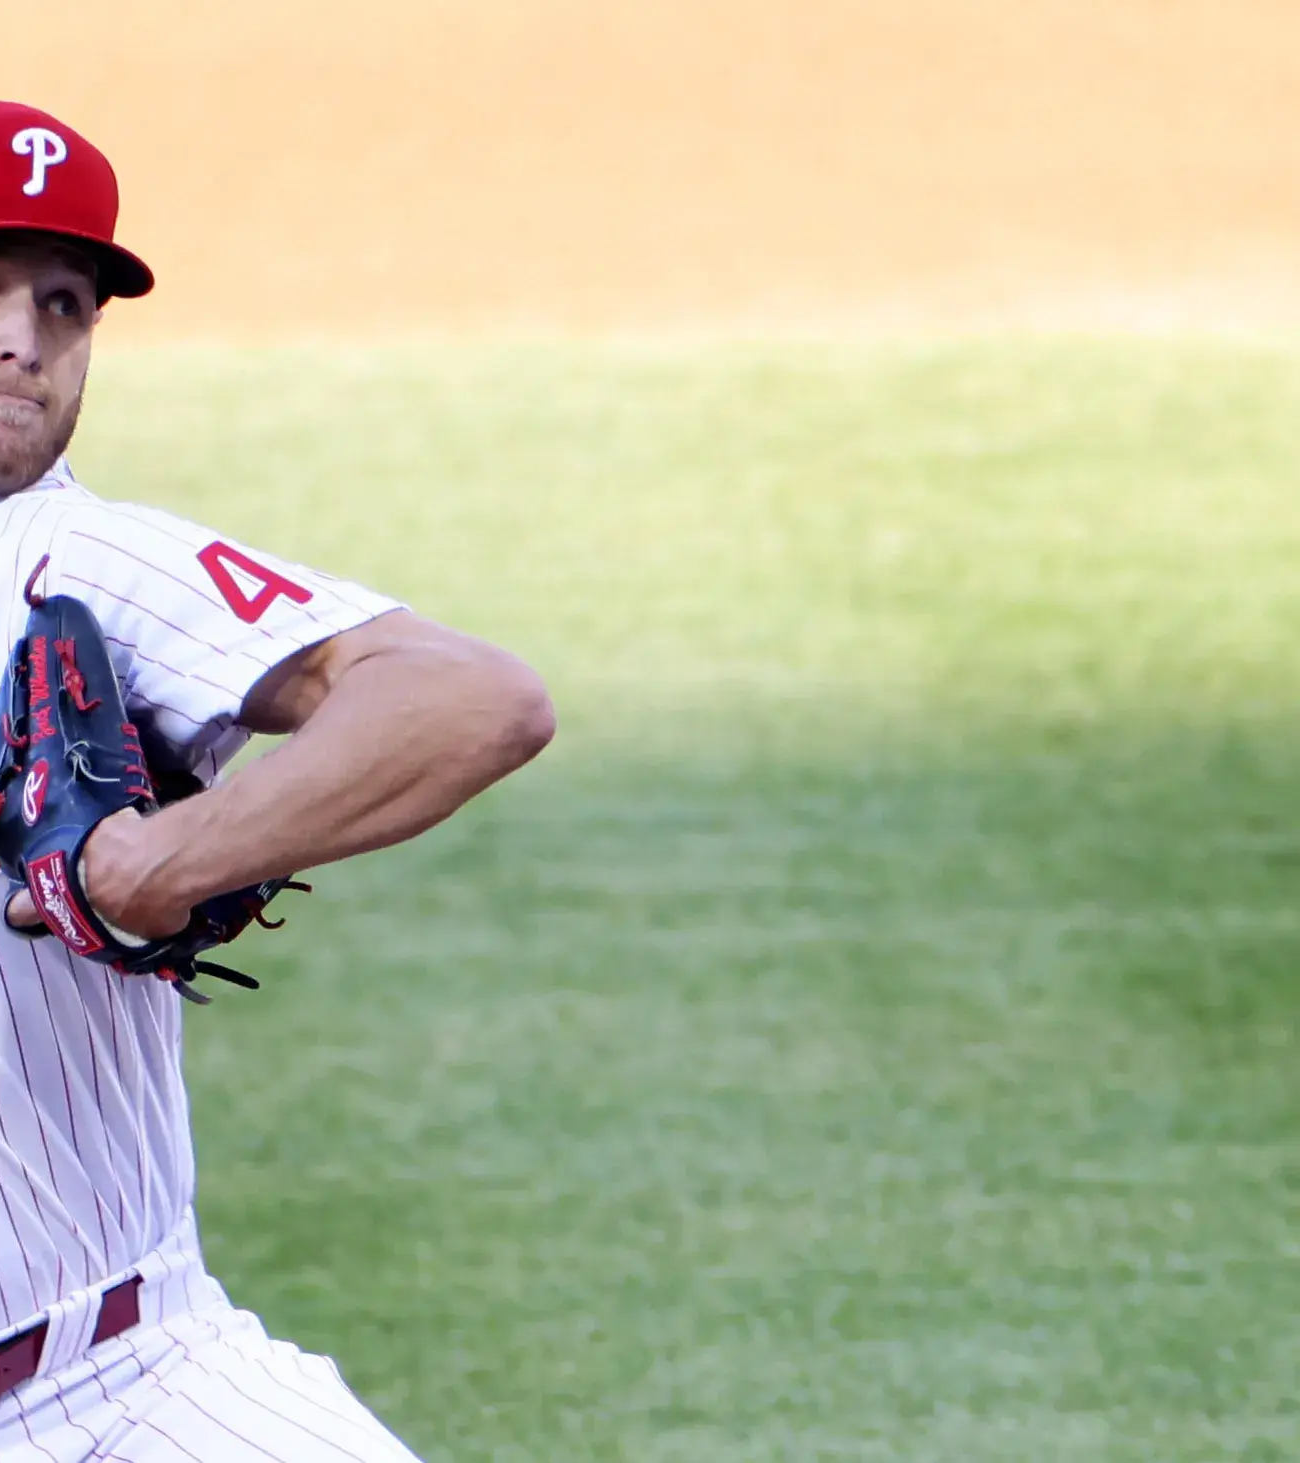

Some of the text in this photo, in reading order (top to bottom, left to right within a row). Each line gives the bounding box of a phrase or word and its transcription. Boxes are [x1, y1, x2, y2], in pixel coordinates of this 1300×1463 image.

[11, 127, 67, 196] P
[196, 540, 313, 624] 4
[38, 868, 87, 947] Rawlings
